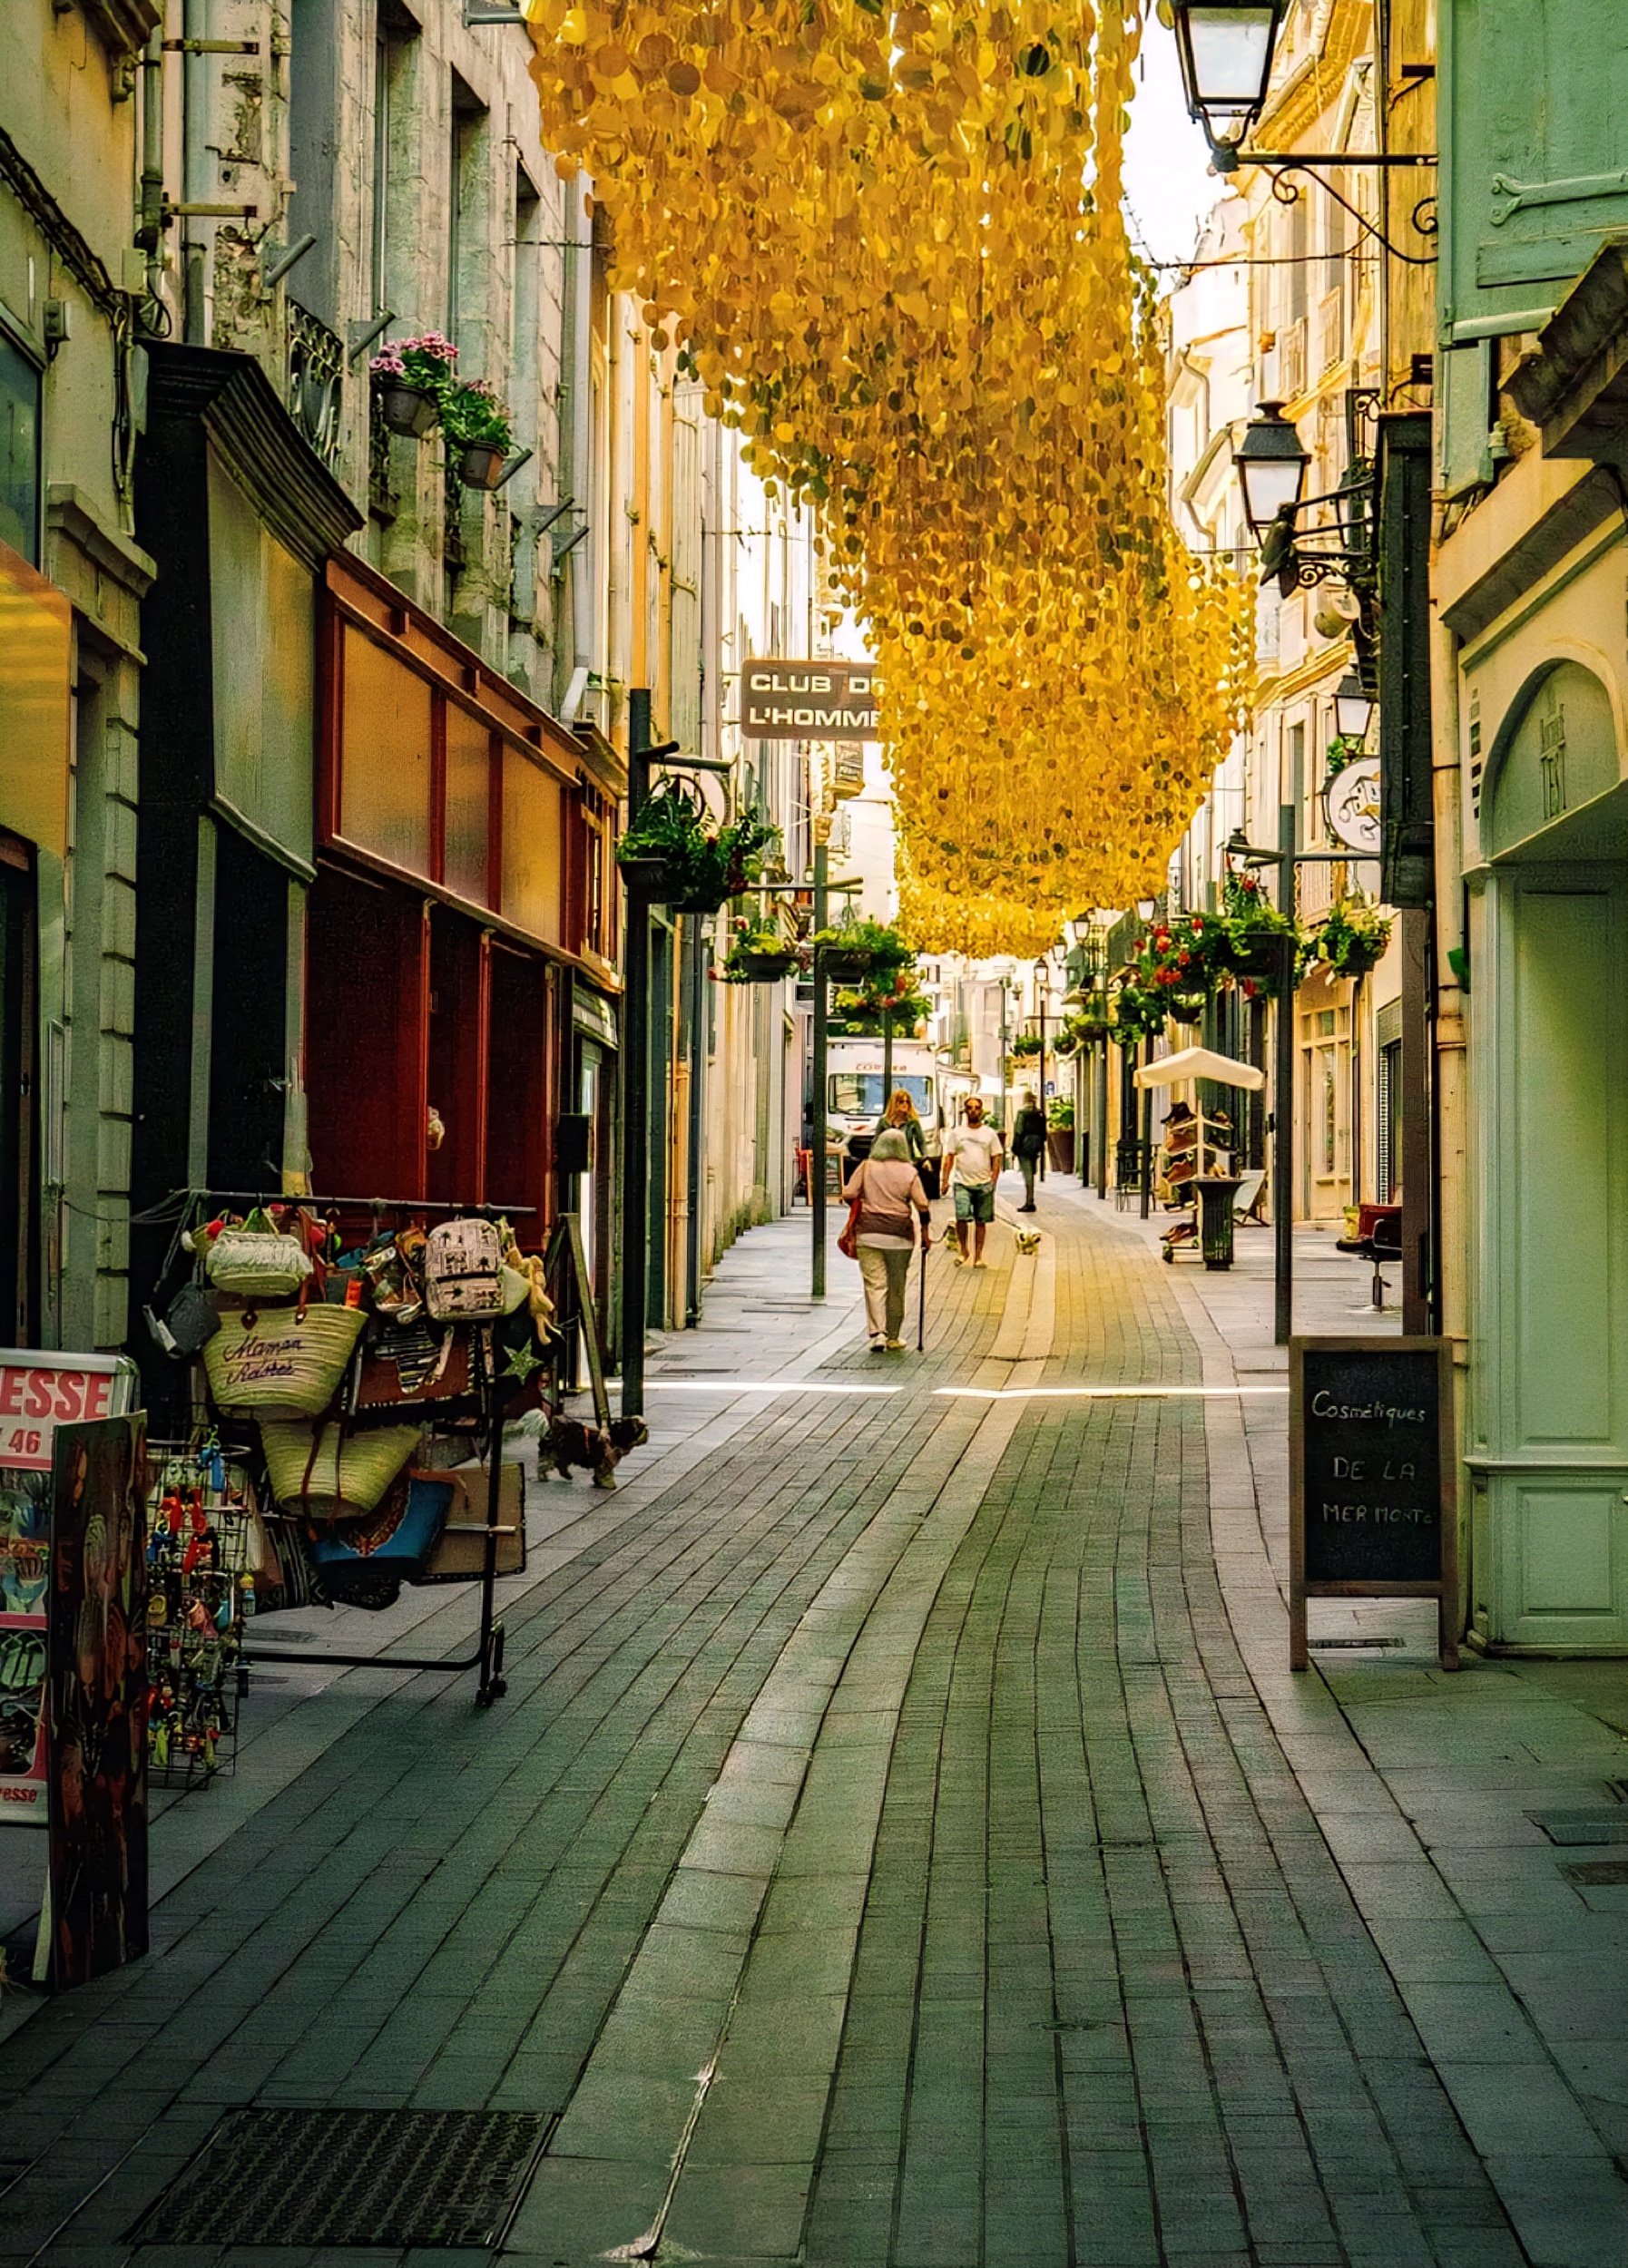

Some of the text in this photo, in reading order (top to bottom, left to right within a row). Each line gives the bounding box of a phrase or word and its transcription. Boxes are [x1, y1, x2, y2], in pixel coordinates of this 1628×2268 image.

[750, 673, 832, 693] CLUB
[0, 1367, 113, 1422] ESSE
[1311, 1390, 1427, 1429] Cosmétiques
[8, 1428, 42, 1454] 46
[1333, 1455, 1416, 1481] DE LA
[1322, 1502, 1368, 1523] MER
